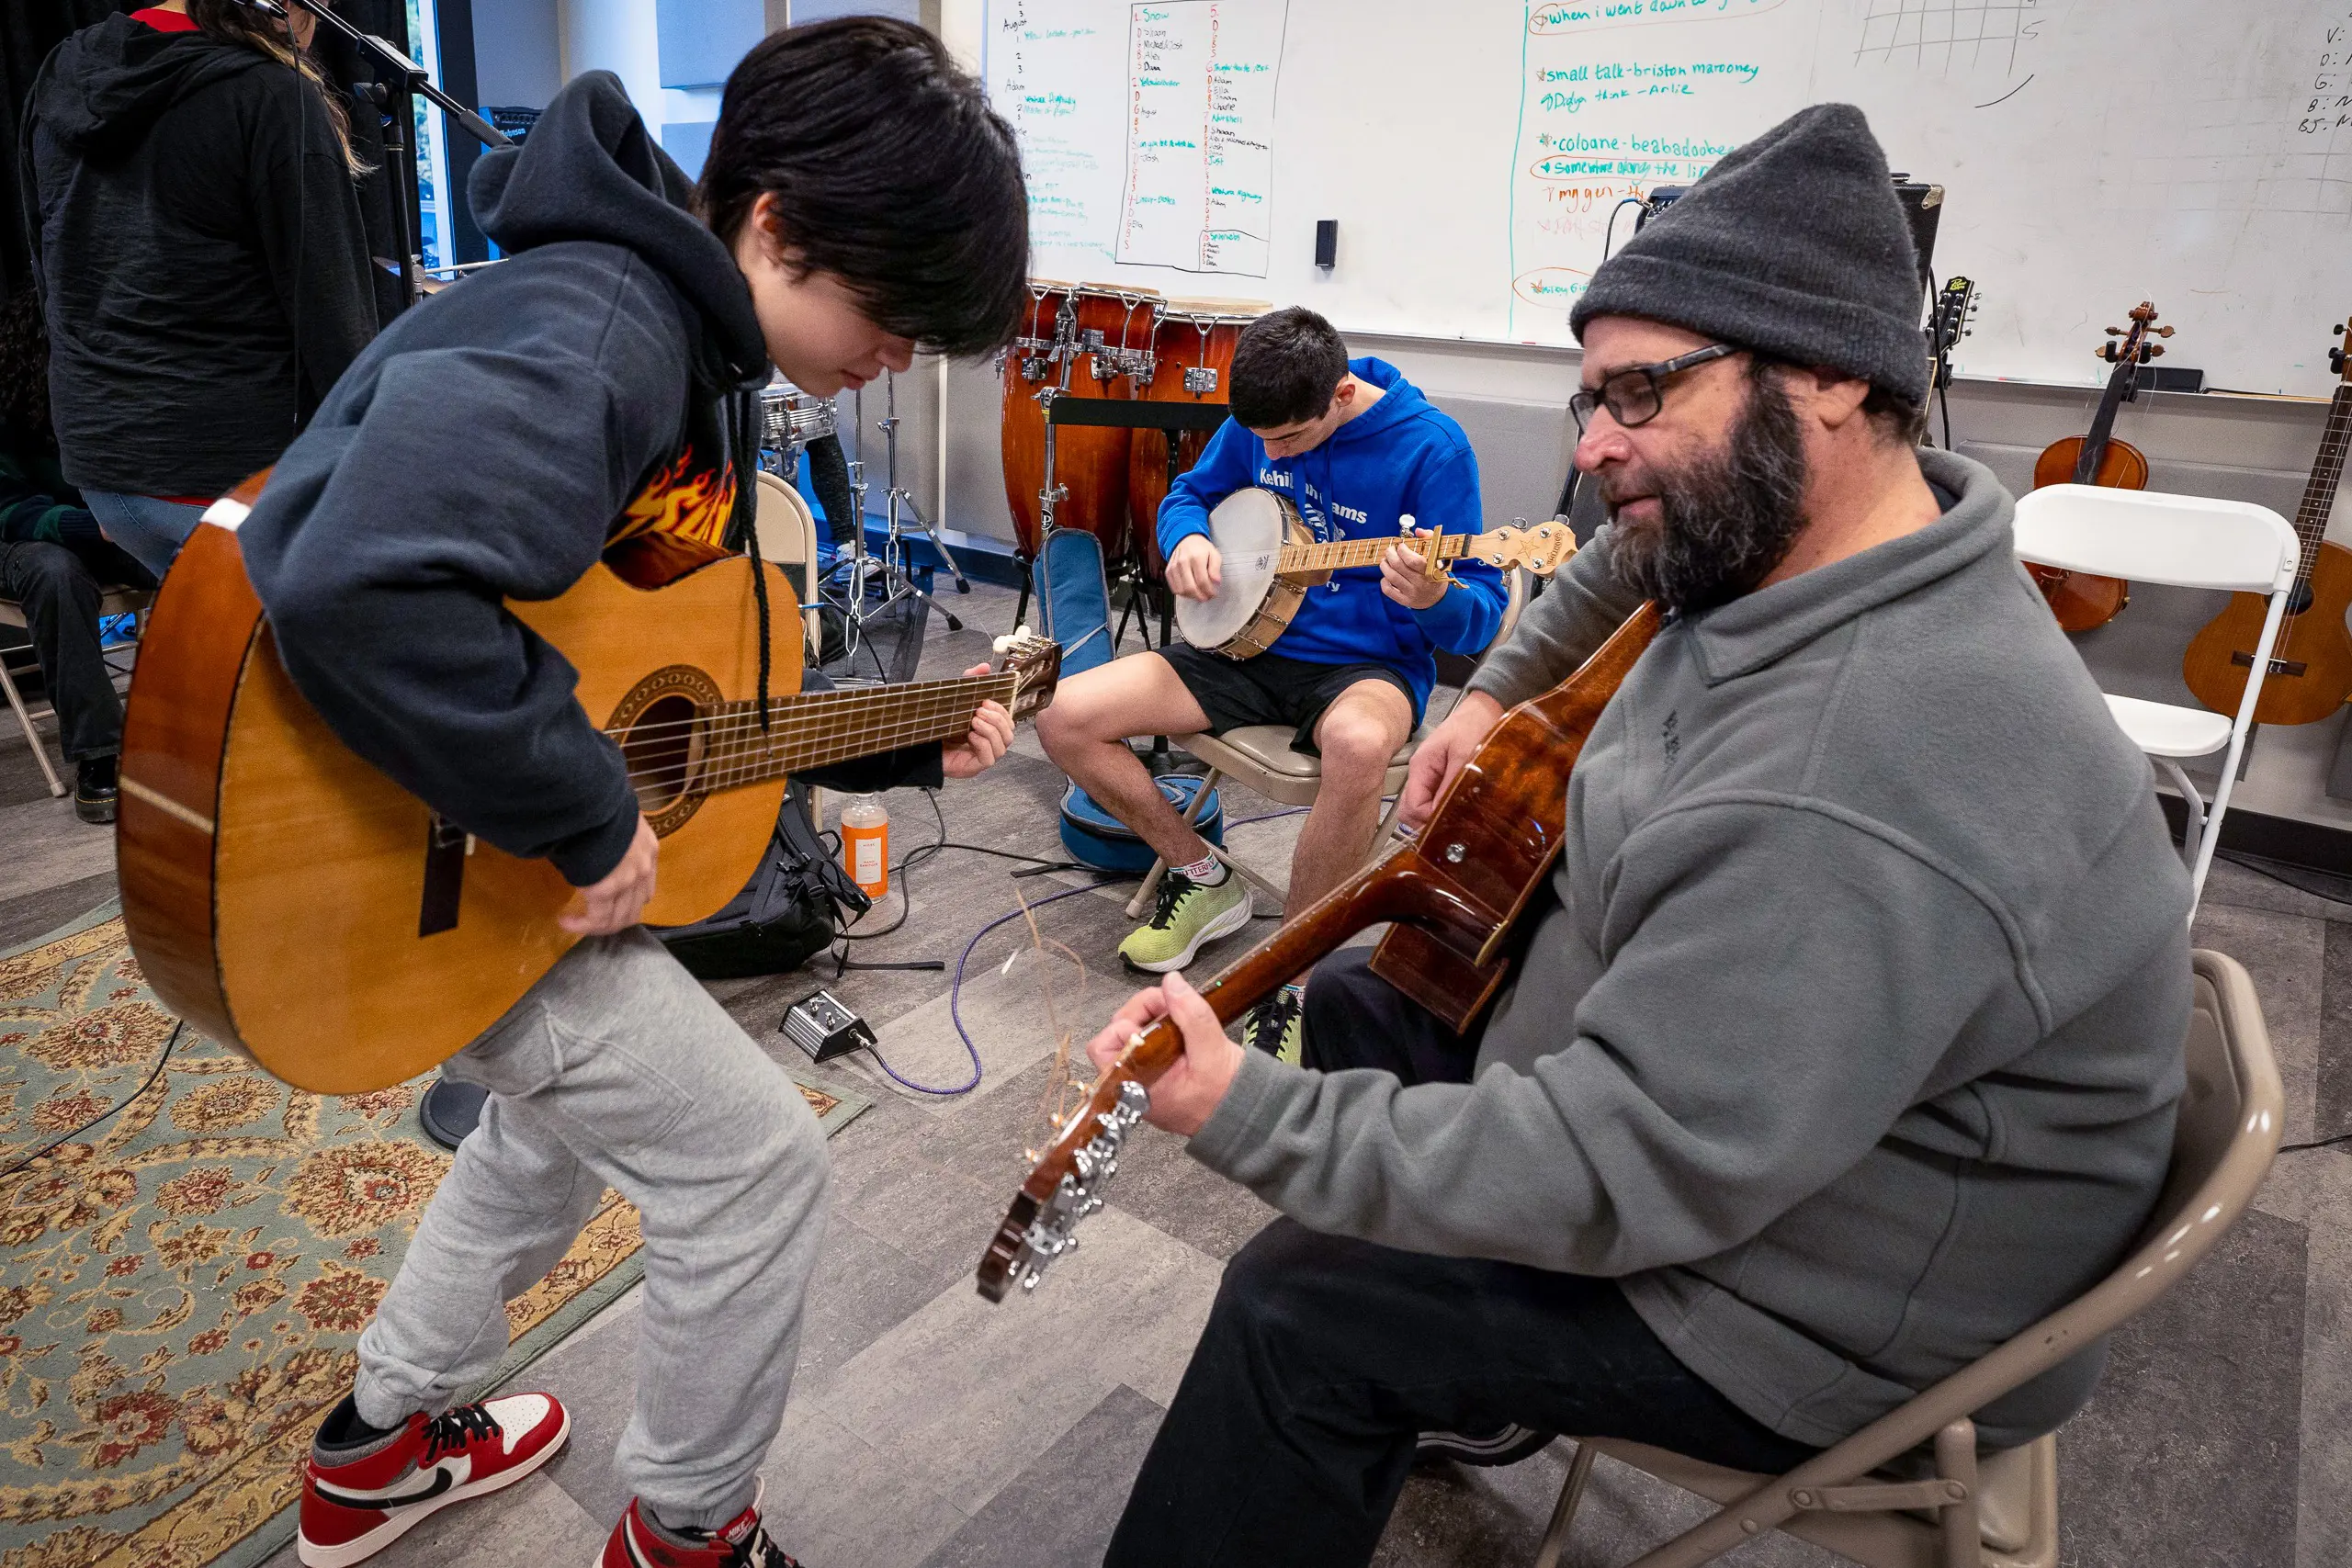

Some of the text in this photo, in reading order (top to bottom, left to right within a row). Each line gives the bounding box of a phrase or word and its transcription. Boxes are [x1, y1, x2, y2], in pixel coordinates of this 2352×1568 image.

[1143, 8, 1170, 22] Snow
[1607, 5, 1643, 17] went
[1002, 18, 1027, 33] August
[1547, 65, 1588, 82] small
[1692, 62, 1758, 84] marooney
[1005, 77, 1025, 93] Adam
[1595, 87, 1629, 101] think
[1654, 161, 1679, 175] the
[1260, 468, 1318, 500] Kehilh
[728, 1520, 746, 1540] NIKE
